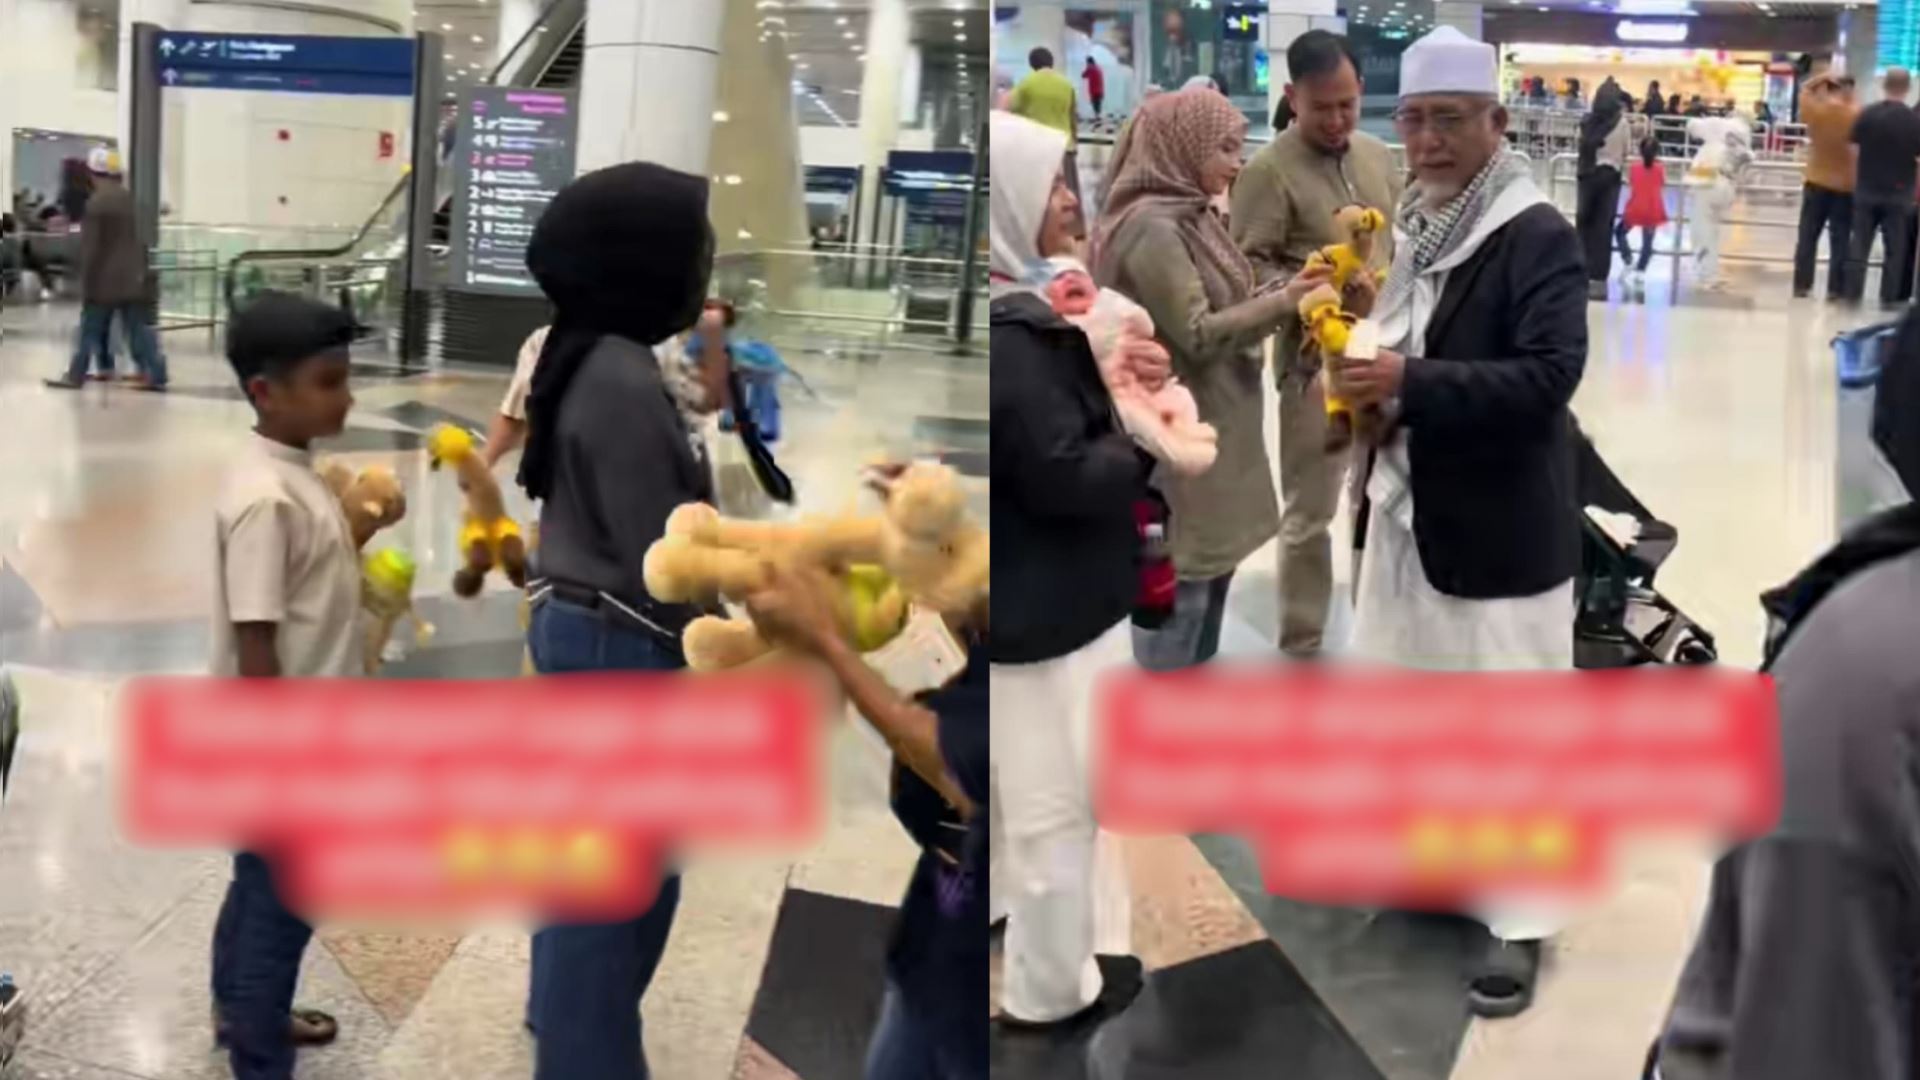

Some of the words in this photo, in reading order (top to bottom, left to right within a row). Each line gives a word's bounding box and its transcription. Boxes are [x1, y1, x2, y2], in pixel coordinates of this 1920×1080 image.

[473, 115, 483, 130] 5
[468, 185, 480, 199] 2
[468, 202, 478, 216] 2
[467, 219, 478, 234] 2
